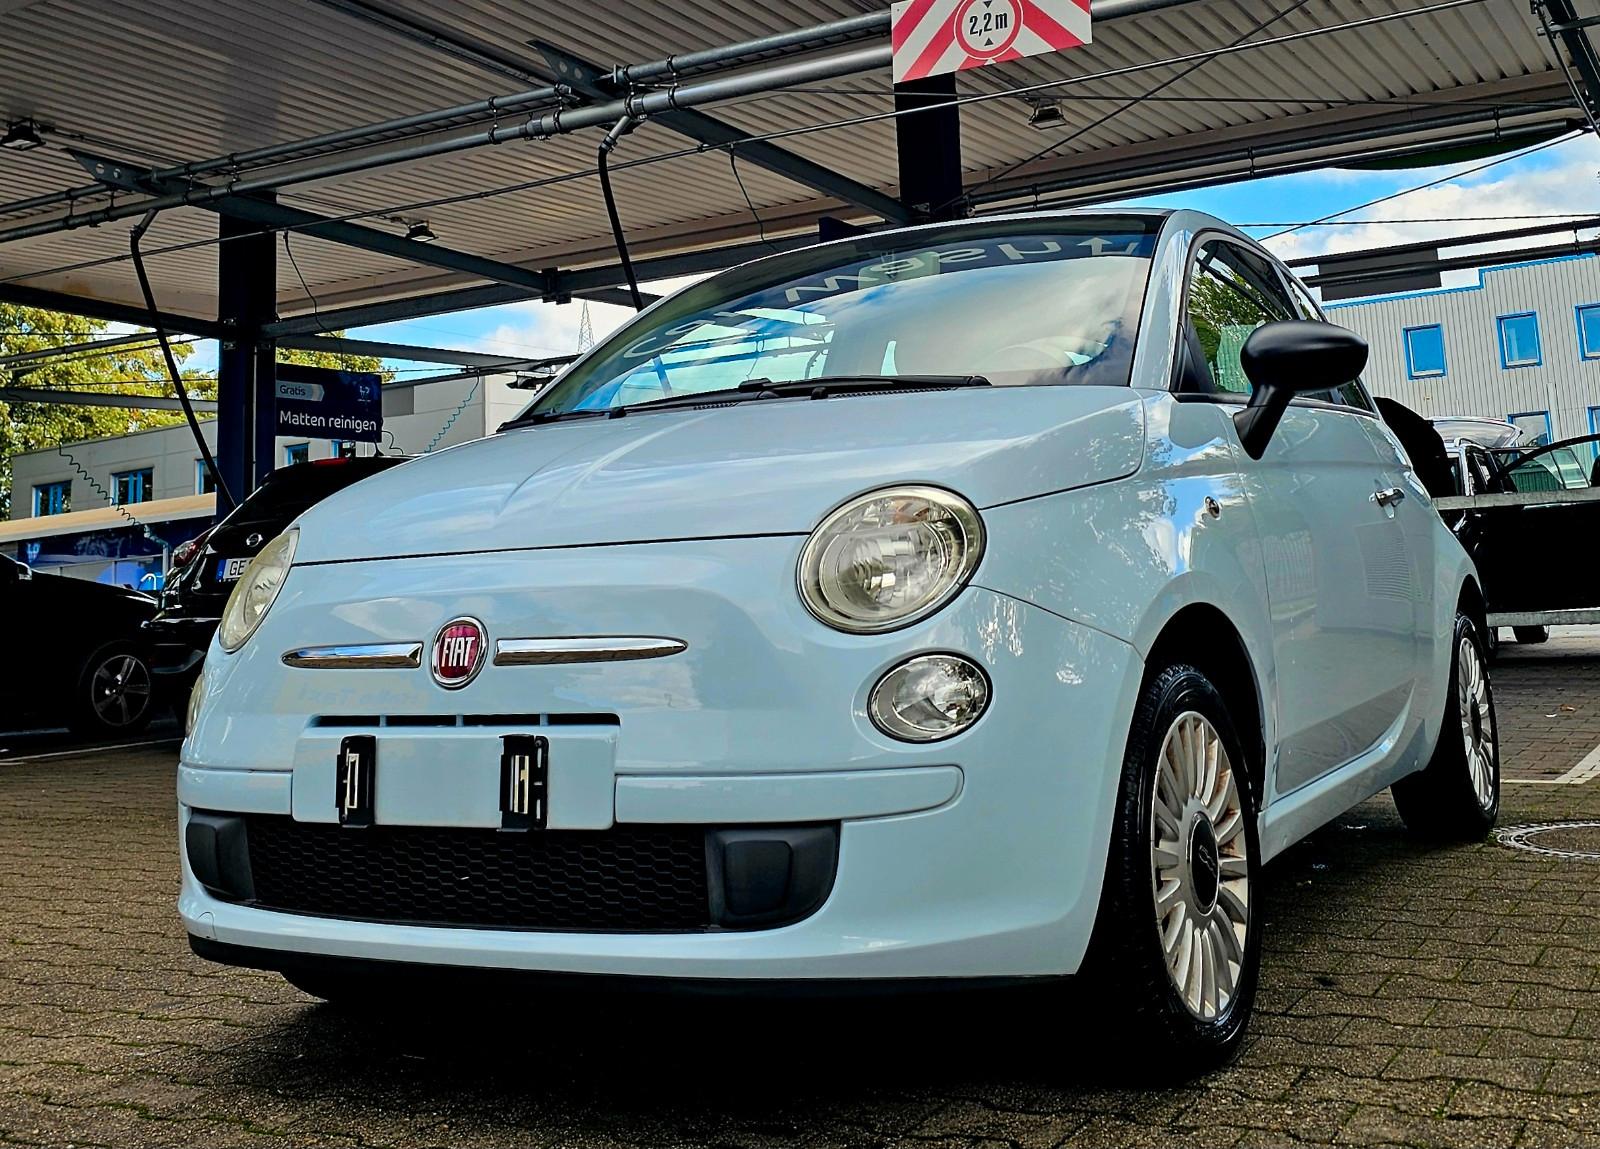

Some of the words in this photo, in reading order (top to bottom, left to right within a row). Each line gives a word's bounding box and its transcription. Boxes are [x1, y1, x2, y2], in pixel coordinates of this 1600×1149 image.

[969, 12, 992, 37] 2,2
[995, 12, 1008, 29] m
[279, 384, 306, 397] Gratis
[279, 410, 326, 427] Matten
[328, 415, 377, 433] reinigen
[441, 636, 476, 668] FIAT
